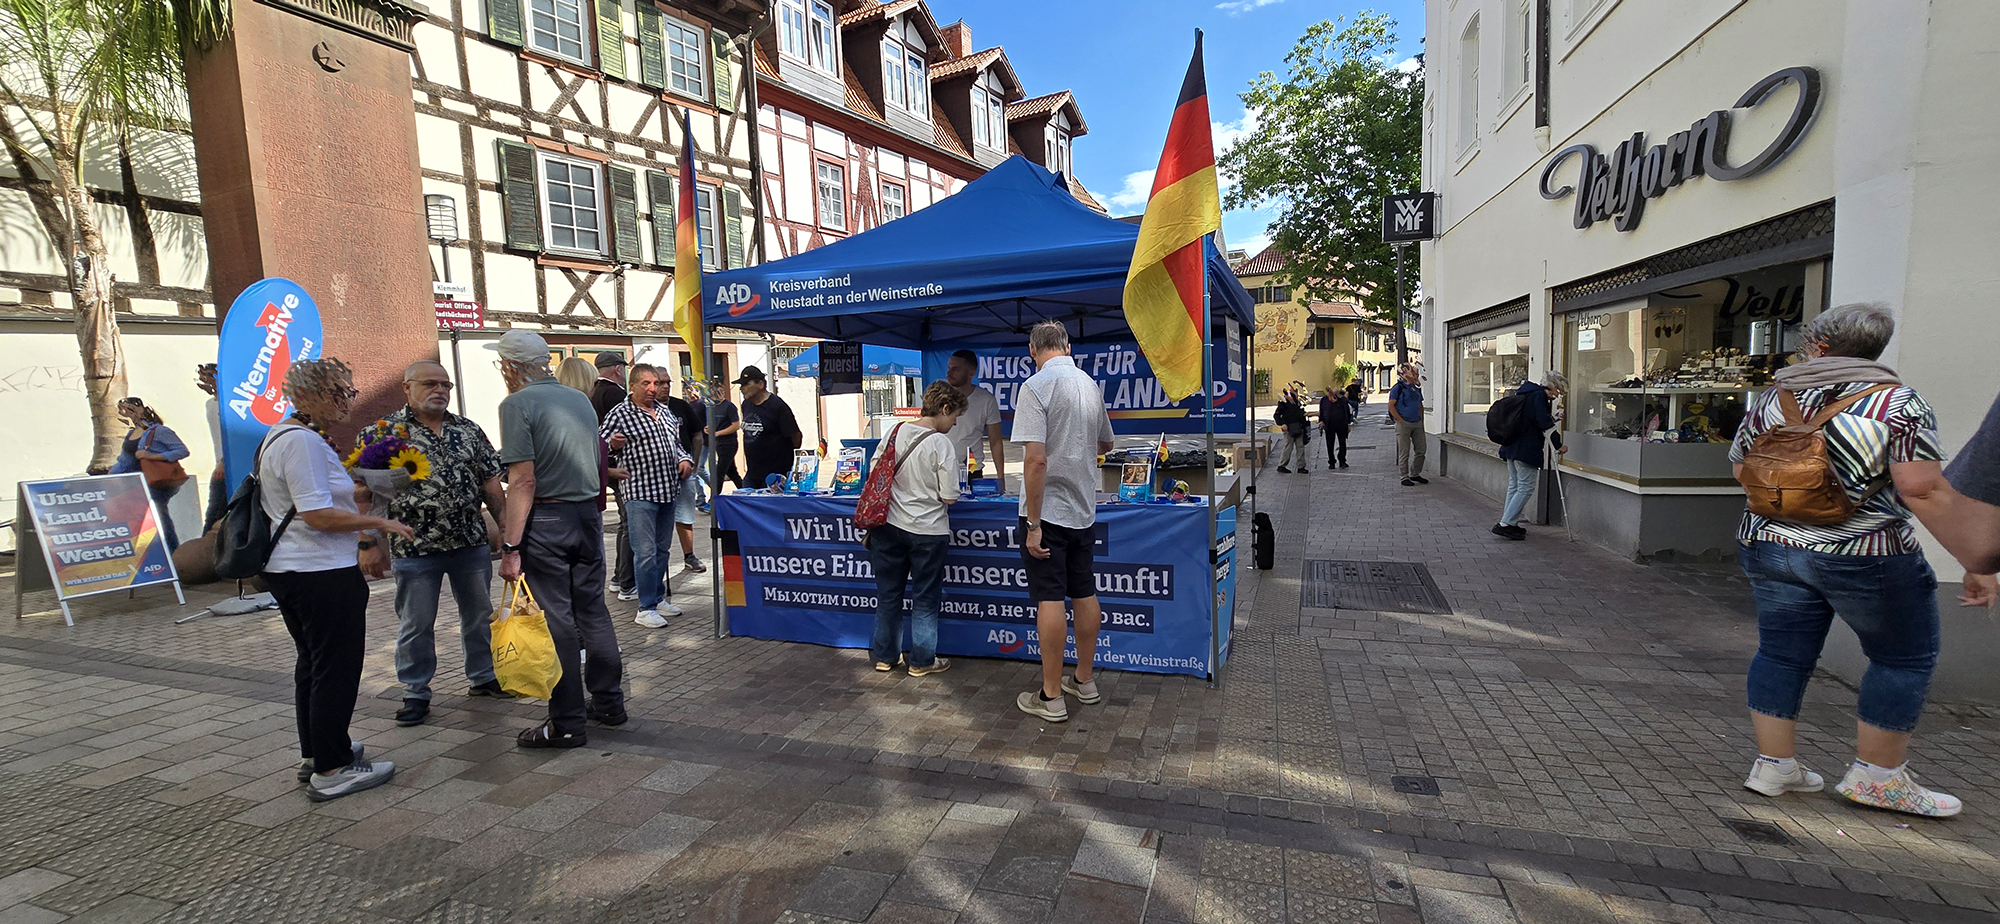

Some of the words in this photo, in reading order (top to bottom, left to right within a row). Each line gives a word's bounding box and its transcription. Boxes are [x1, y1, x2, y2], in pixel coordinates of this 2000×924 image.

[1539, 66, 1820, 232] Velhorn
[769, 274, 851, 293] Kreisverband
[716, 282, 751, 305] AfD
[770, 292, 825, 310] Neustadt
[827, 293, 843, 305] an
[846, 290, 867, 303] der
[867, 282, 944, 302] Weinstraße
[435, 311, 473, 319] tadtbücherei
[228, 293, 300, 420] Alternative
[824, 343, 842, 355] Unser
[843, 343, 858, 355] Land
[824, 356, 859, 373] zuerst!
[978, 353, 1089, 379] NEUST
[1093, 344, 1136, 376] FÜR
[265, 386, 278, 401] für
[1190, 381, 1227, 397] AD
[37, 490, 106, 507] Unser
[44, 507, 107, 526] Land,
[50, 526, 129, 545] unsere
[787, 517, 833, 541] Wir
[56, 542, 132, 564] Werte!
[144, 564, 162, 573] AfD
[747, 554, 826, 575] unsere
[764, 587, 790, 602] Мы
[792, 592, 839, 605] хотим
[988, 606, 998, 617] а
[1001, 606, 1023, 618] не
[1112, 613, 1150, 628] вас.
[987, 630, 1017, 644] AfD
[1103, 651, 1125, 664] der
[1128, 653, 1204, 671] Weinstraße
